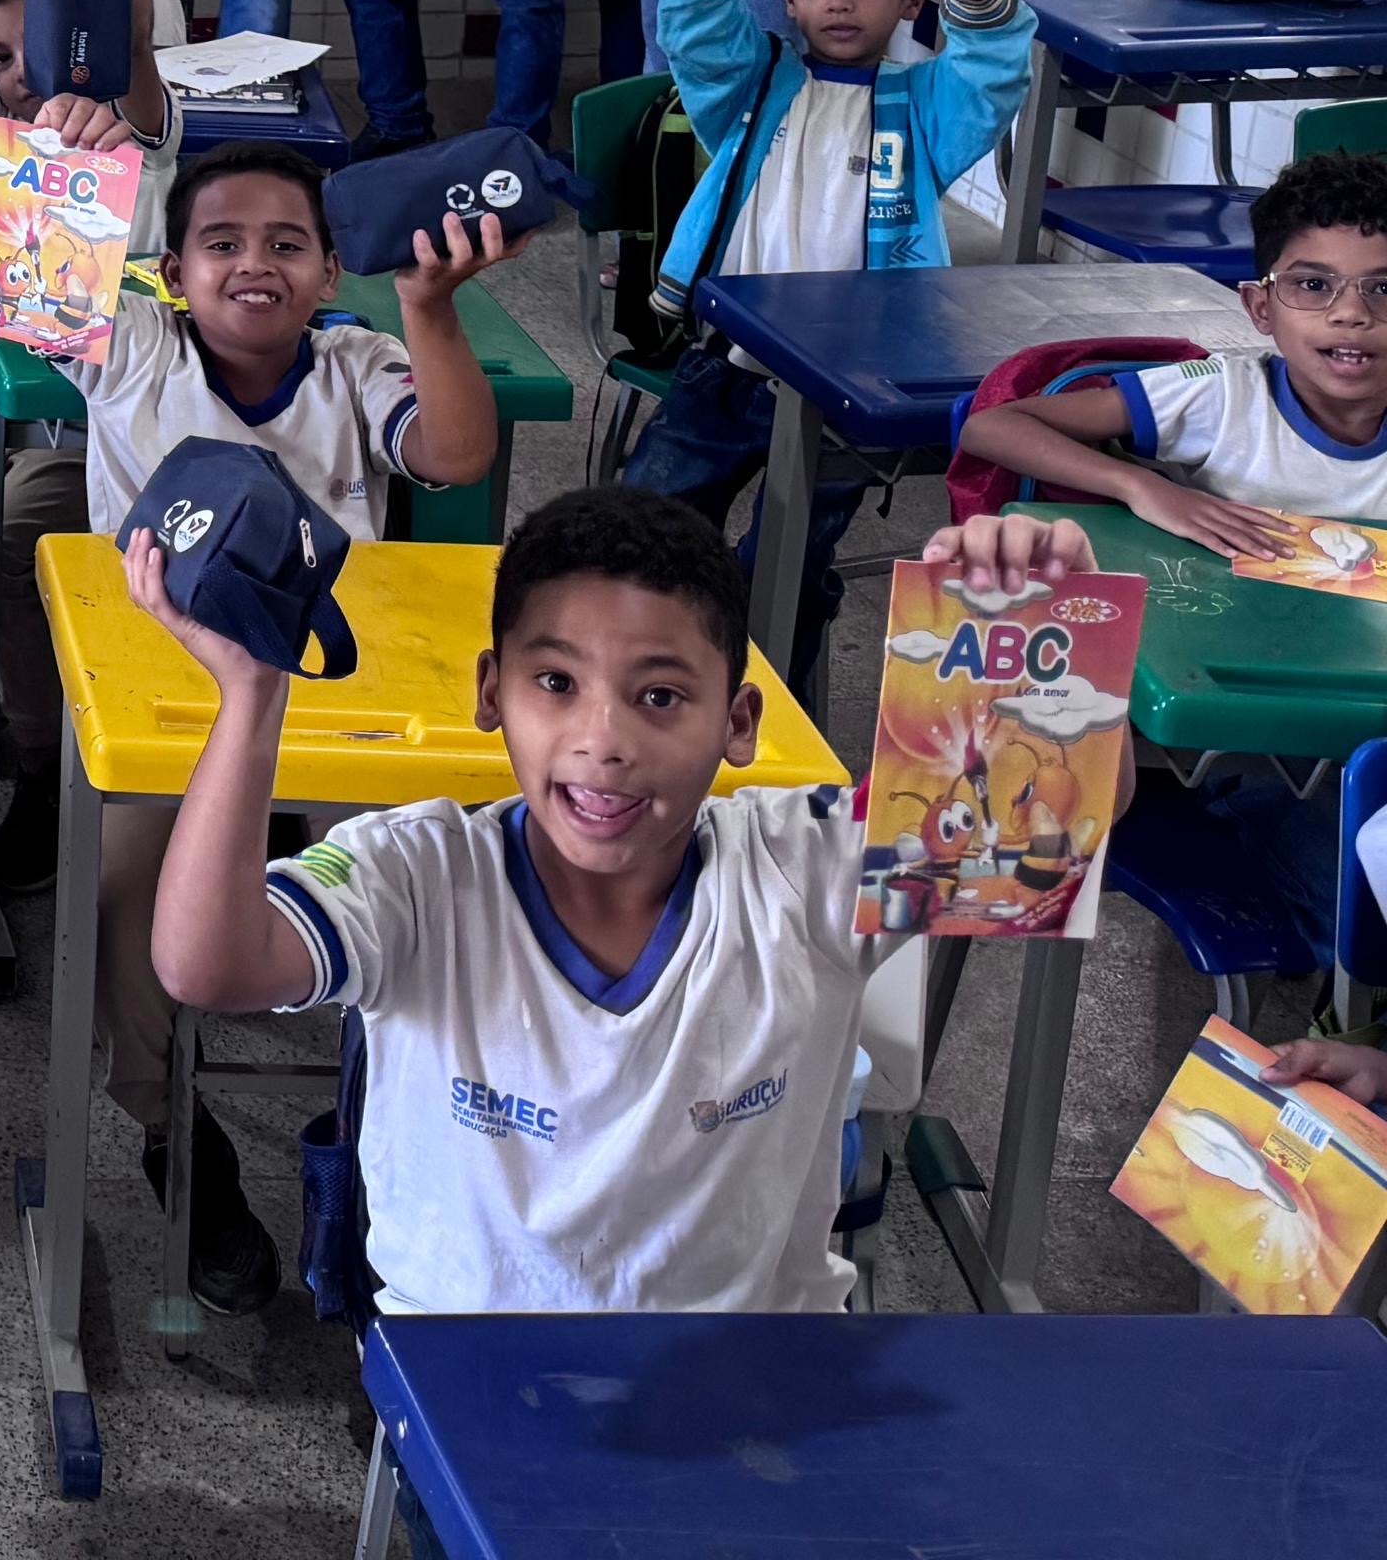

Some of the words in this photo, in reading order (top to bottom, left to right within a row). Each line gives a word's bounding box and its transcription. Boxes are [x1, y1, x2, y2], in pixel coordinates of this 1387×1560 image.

[77, 31, 88, 63] Rotary
[10, 157, 96, 204] ABC
[938, 620, 1071, 686] ABC
[451, 1077, 558, 1133] SEMEC
